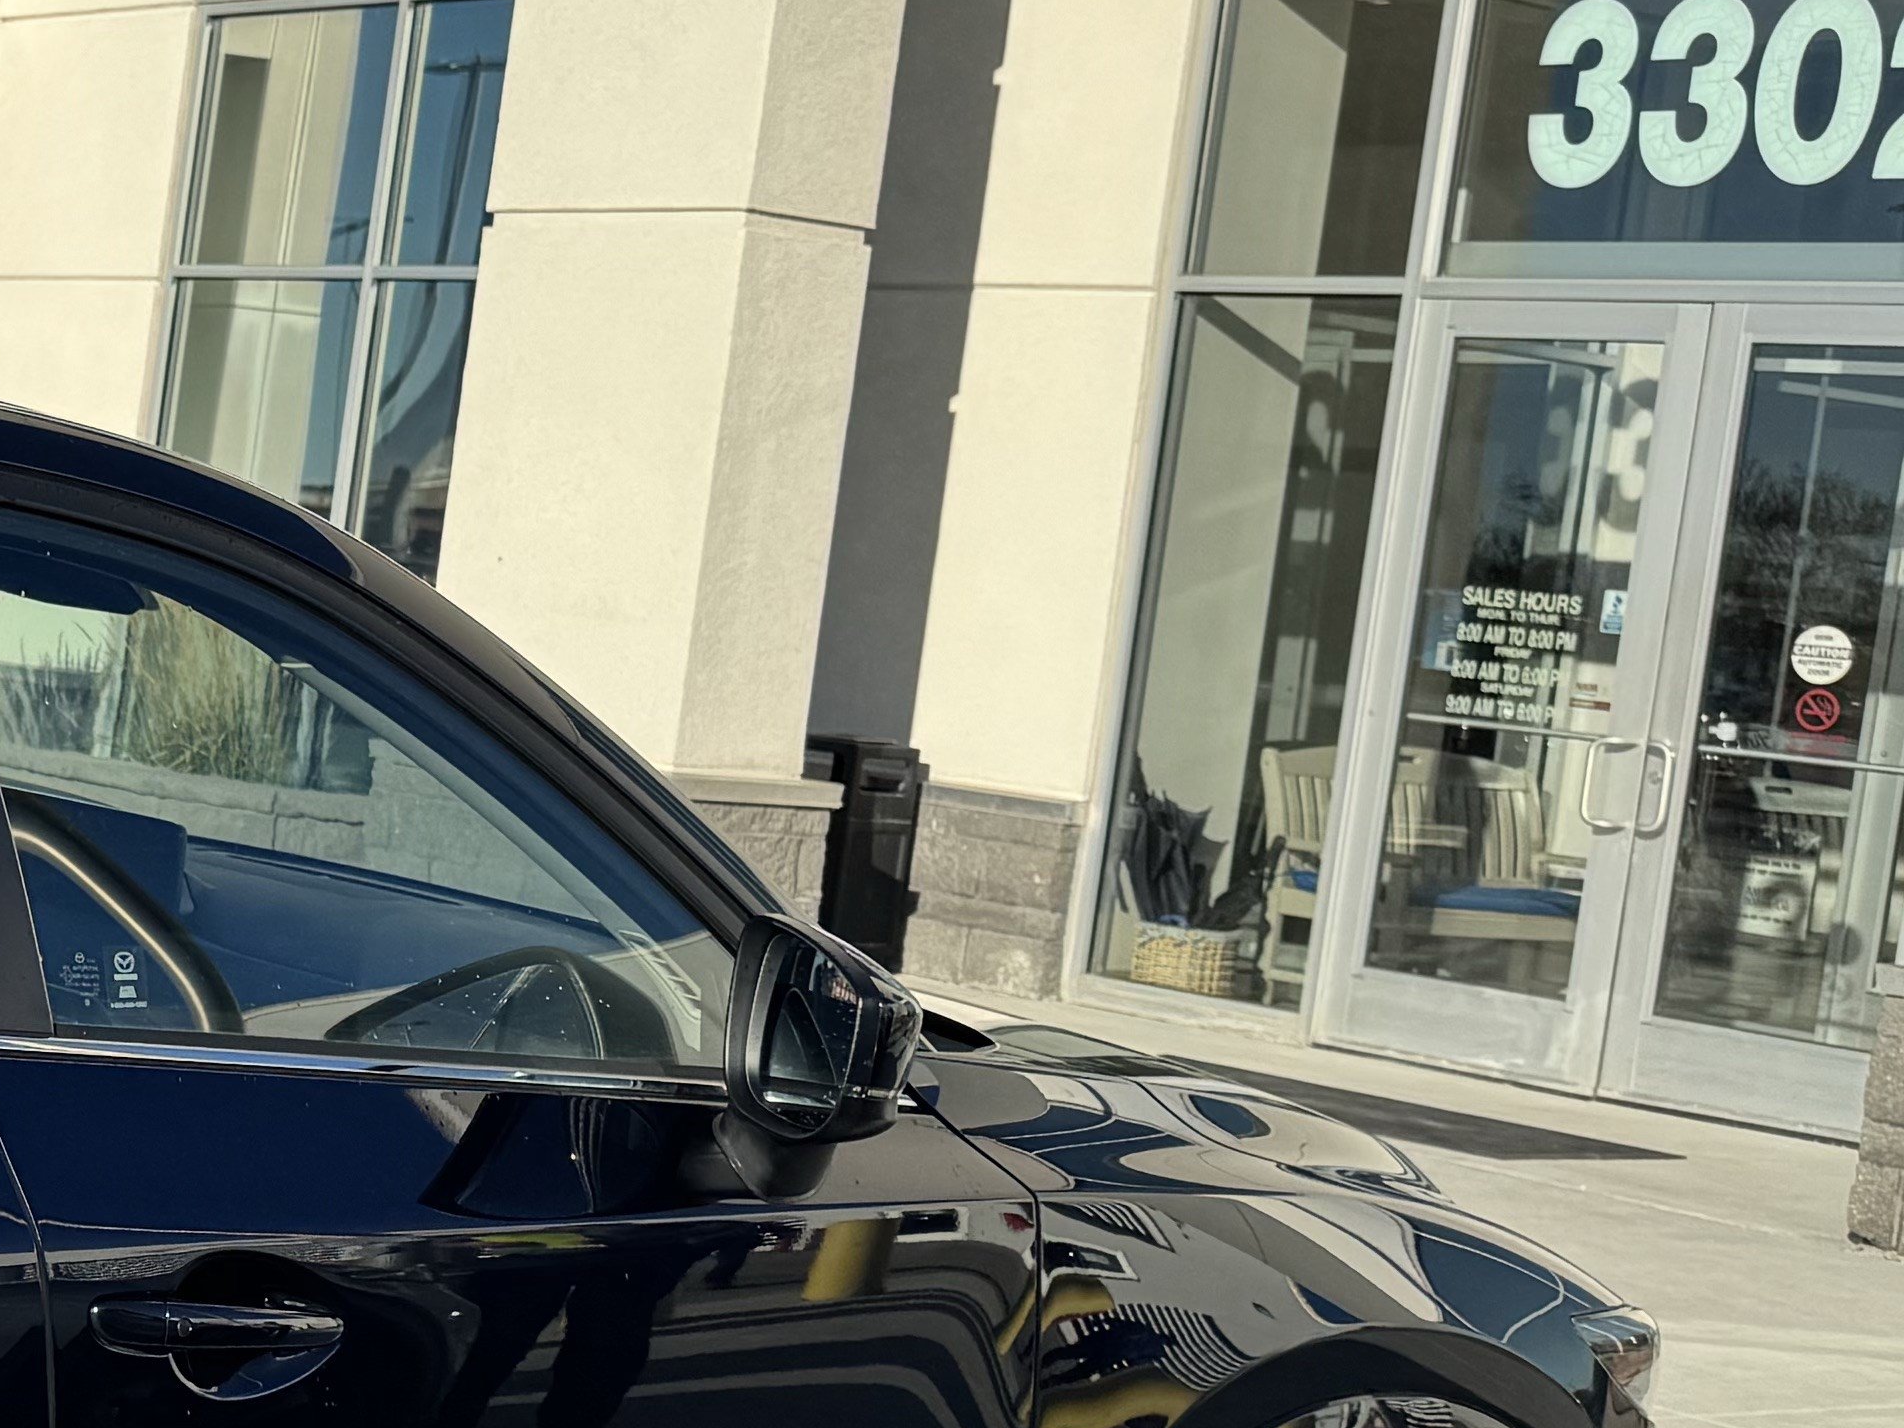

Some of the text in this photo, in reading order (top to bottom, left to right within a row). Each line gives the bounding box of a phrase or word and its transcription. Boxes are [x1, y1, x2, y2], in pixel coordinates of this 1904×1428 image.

[1462, 585, 1583, 615] SALES HOURS
[1510, 610, 1527, 622] TO
[1483, 623, 1506, 645] AM
[1508, 626, 1526, 646] TO
[1555, 631, 1578, 652] PM
[1793, 645, 1852, 660] CAUTION
[1477, 661, 1500, 681] AM
[1503, 663, 1520, 683] TO
[1797, 659, 1843, 669] AUTOMATIC
[1473, 697, 1496, 717] AM
[1497, 699, 1515, 720] TO
